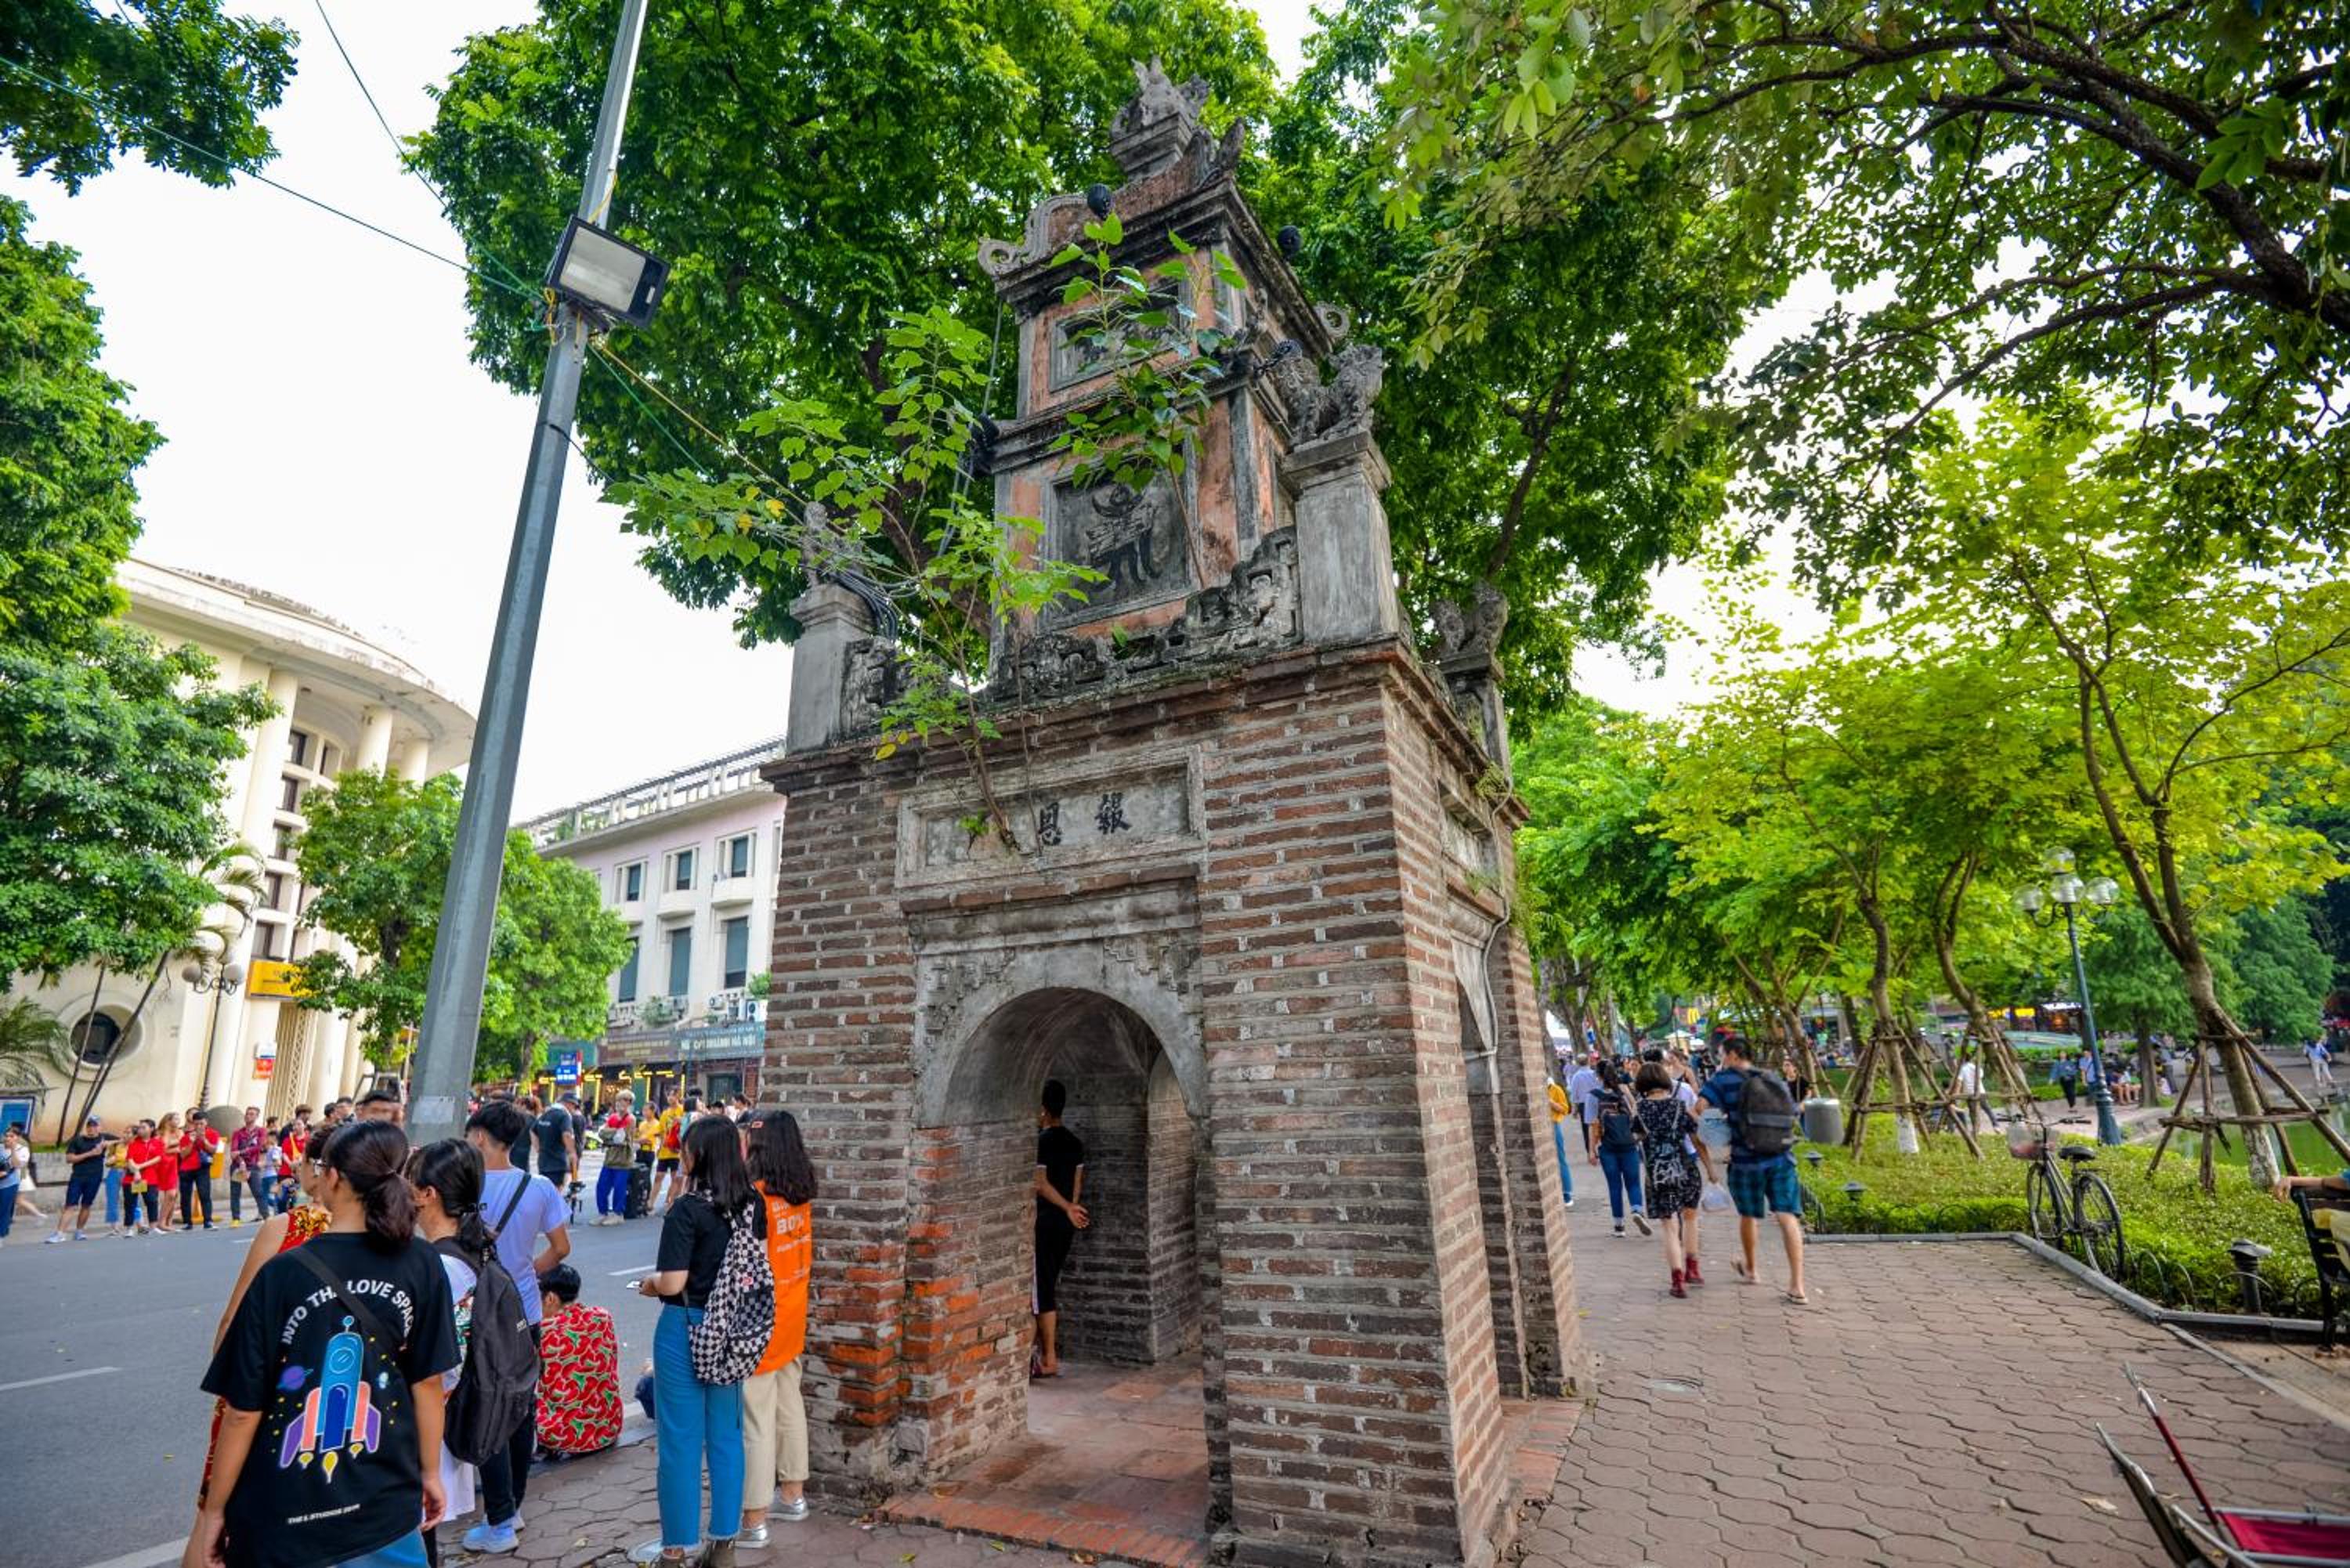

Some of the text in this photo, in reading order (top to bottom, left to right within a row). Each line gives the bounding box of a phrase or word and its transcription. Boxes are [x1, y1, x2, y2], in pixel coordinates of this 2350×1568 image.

[281, 1306, 307, 1345] INTO
[306, 1286, 337, 1307] TH
[346, 1279, 394, 1299] LOVE
